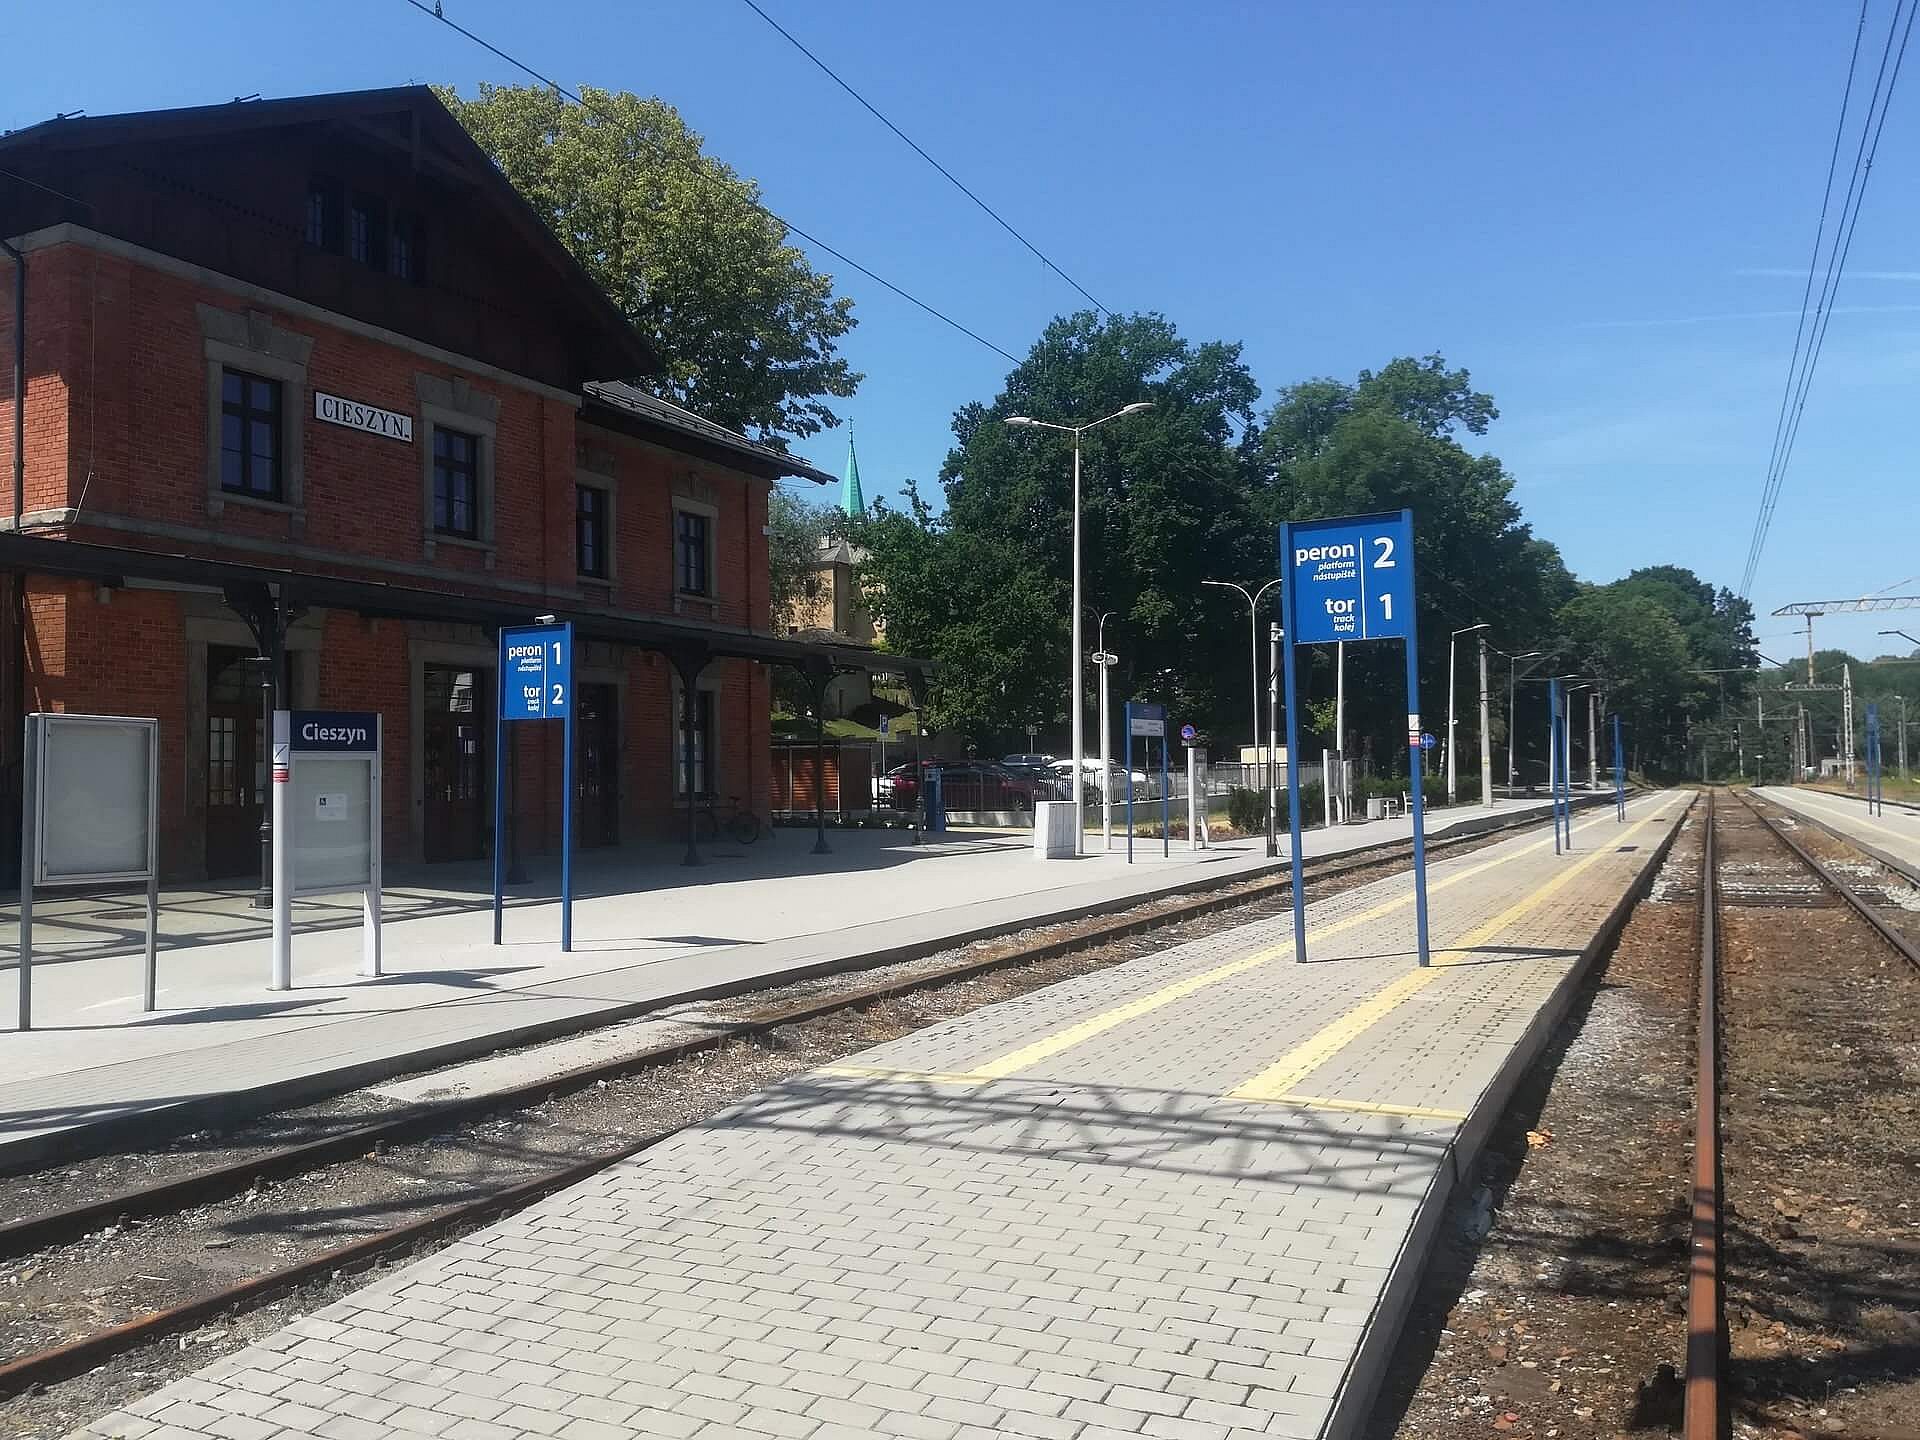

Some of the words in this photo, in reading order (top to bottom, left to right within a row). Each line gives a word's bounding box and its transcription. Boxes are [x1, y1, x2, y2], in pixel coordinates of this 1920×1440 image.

[1295, 544, 1355, 566] peron
[1373, 537, 1396, 569] 2
[1318, 561, 1354, 572] platform
[1324, 598, 1356, 614] tor
[1379, 594, 1392, 620] 1
[1333, 614, 1355, 623] track
[1334, 623, 1355, 632] kolej
[508, 645, 542, 661] peron
[553, 641, 561, 665] 1
[523, 685, 541, 698] tor
[552, 684, 564, 705] 2
[302, 722, 367, 745] Cieszyn
